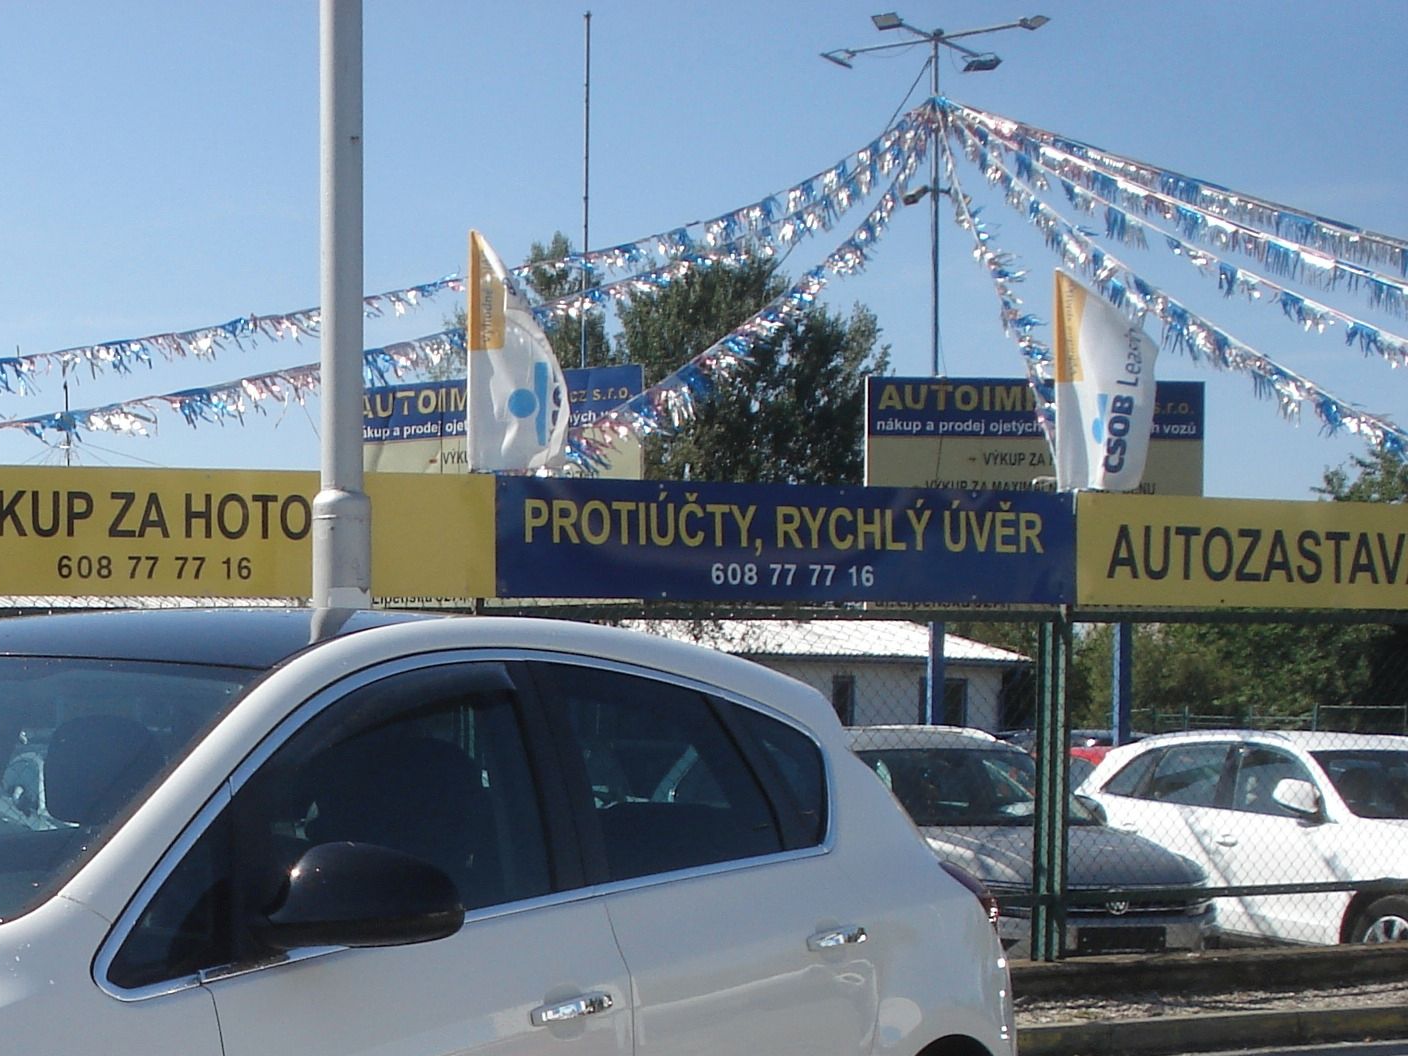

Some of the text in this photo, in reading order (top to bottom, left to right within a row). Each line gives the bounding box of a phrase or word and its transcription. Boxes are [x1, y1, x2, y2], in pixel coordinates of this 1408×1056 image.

[363, 386, 468, 419] AUTOIM
[878, 384, 1035, 412] AUTOIM
[403, 420, 441, 439] prodej
[876, 418, 1043, 435] nákup a prodej ojetých
[983, 449, 1026, 466] VÝKUP
[1029, 452, 1045, 466] ZA
[108, 492, 171, 539] ZA
[184, 493, 313, 541] HOTO
[524, 492, 1042, 556] PROTIÚČTY, RYCHLÝ ÚVĚR
[1105, 523, 1408, 585] AUTOZASTAV
[57, 555, 252, 581] 608 77 77 16
[711, 563, 875, 587] 608 77 77 16
